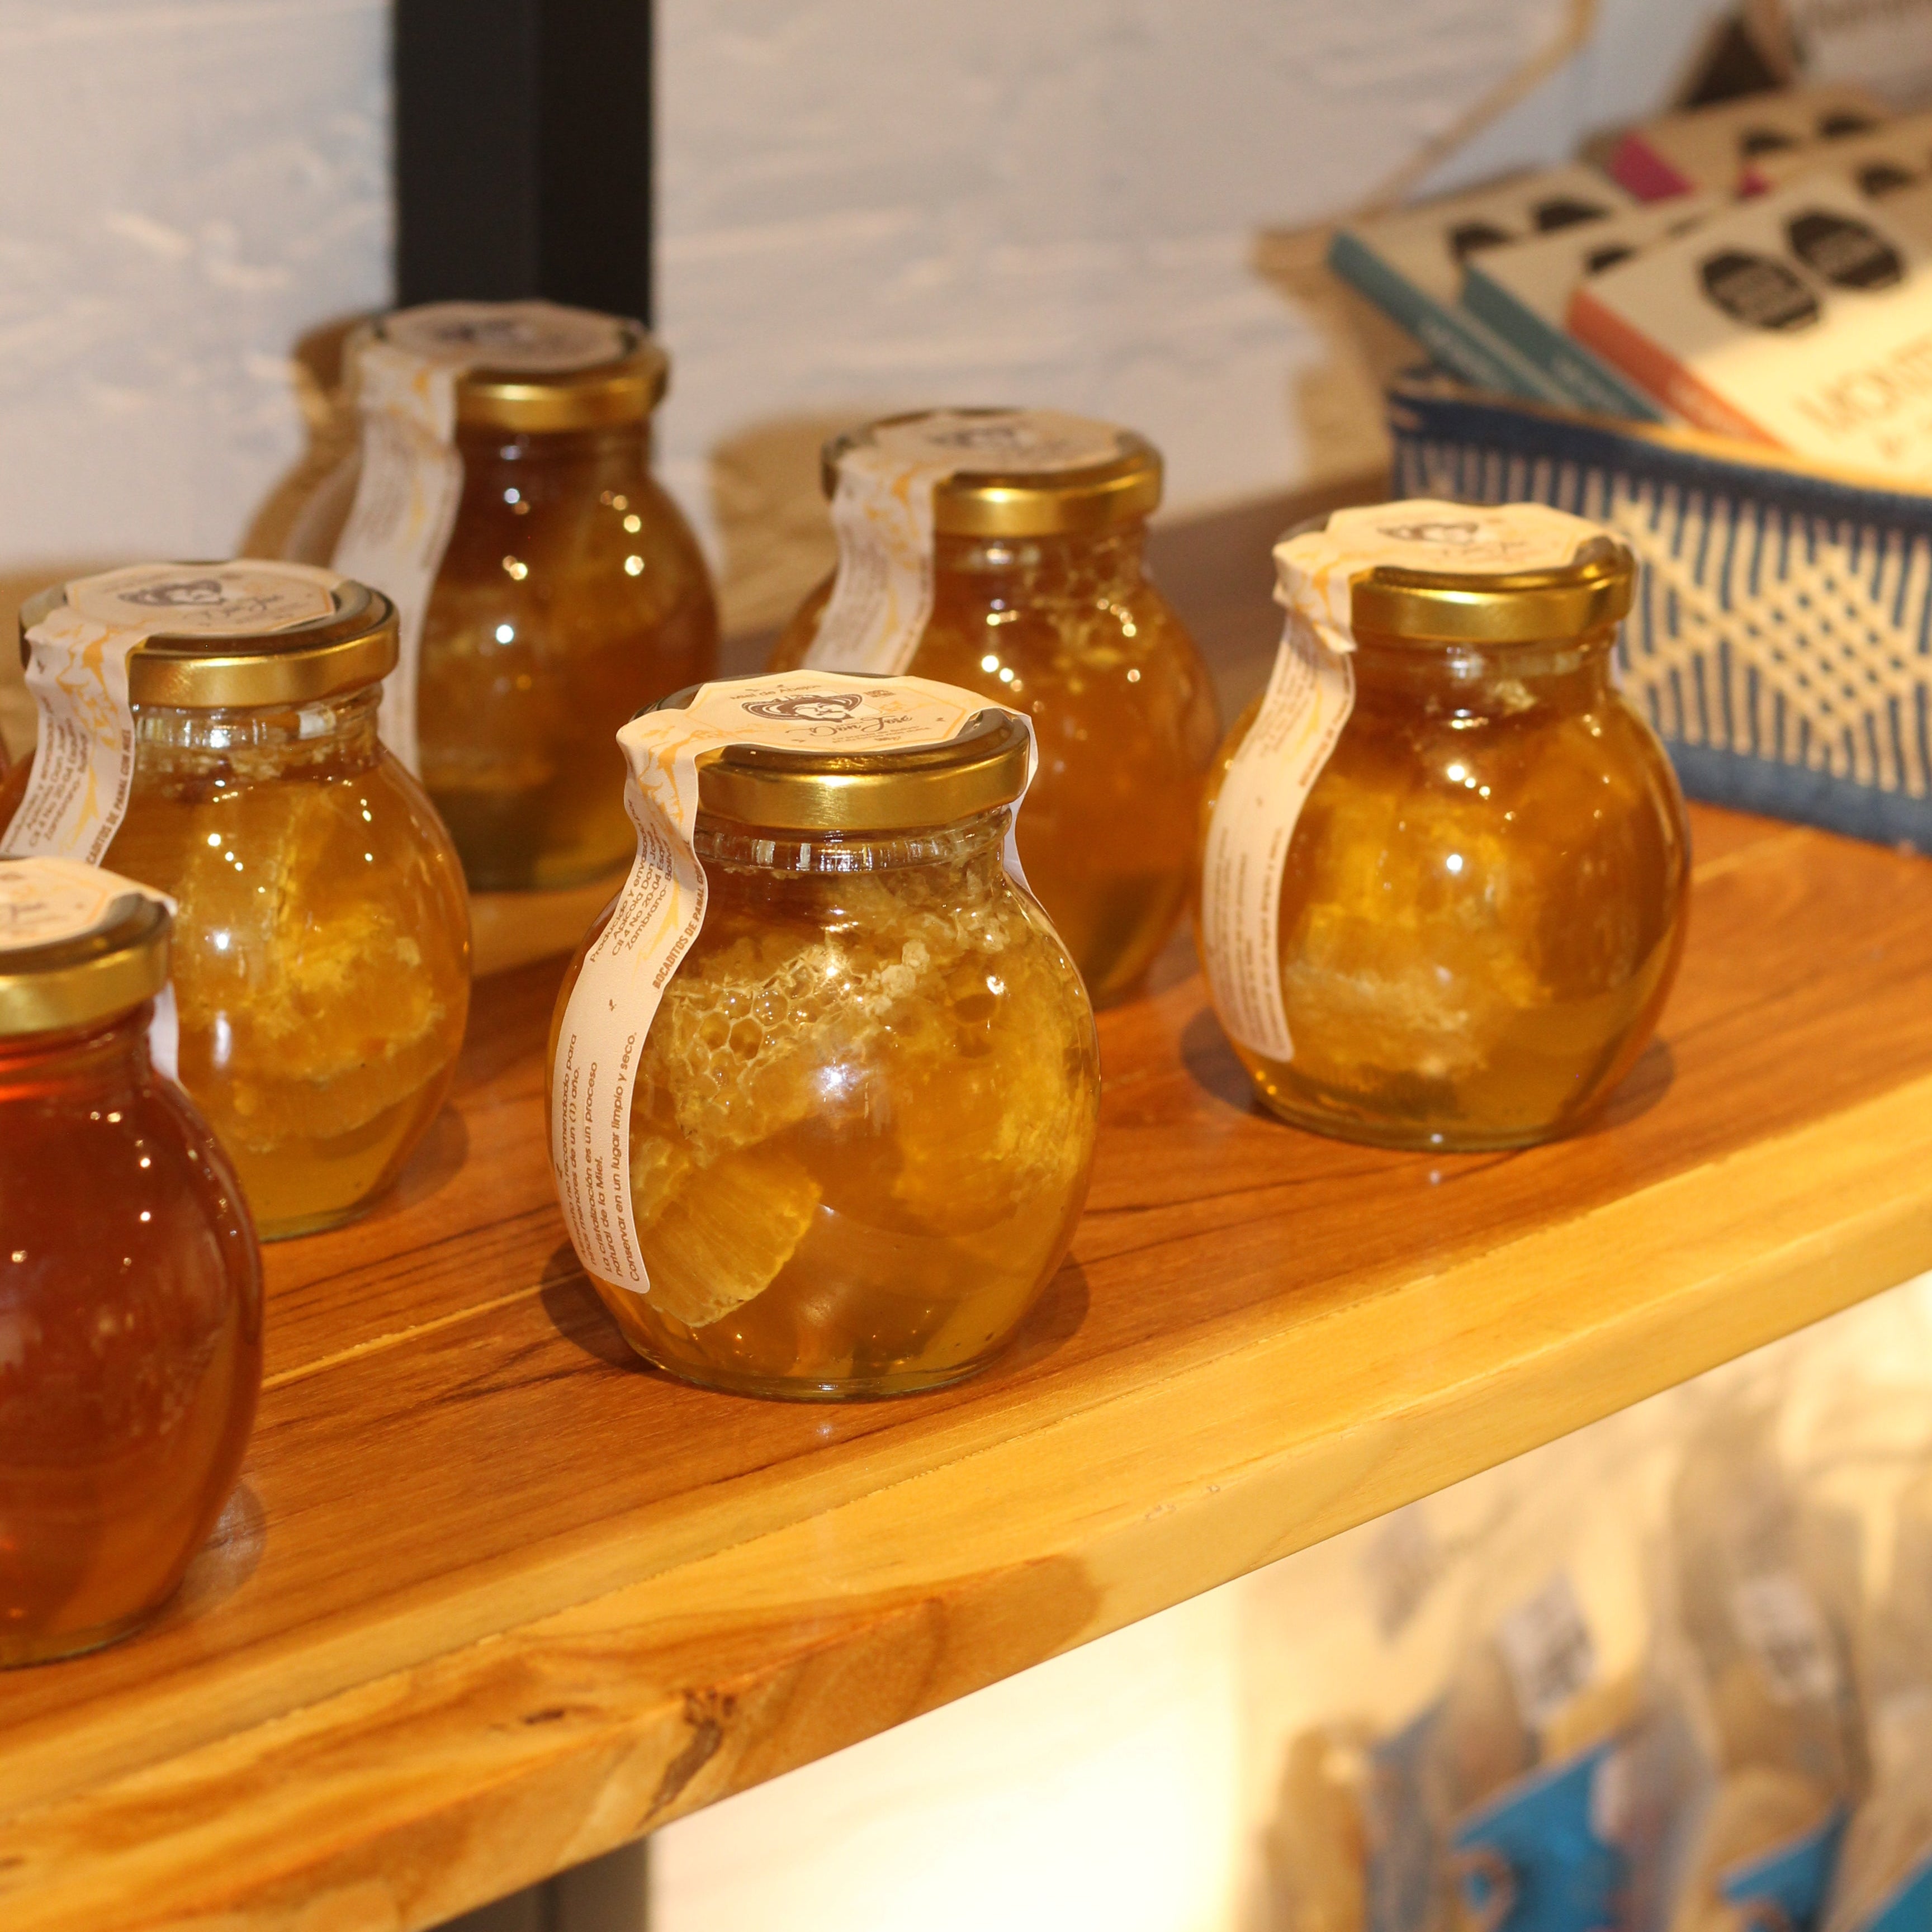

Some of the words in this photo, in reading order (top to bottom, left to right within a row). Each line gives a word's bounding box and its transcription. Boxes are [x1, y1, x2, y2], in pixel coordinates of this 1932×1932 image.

[106, 810, 119, 826] DE
[641, 863, 654, 891] Don
[590, 900, 628, 963] Producido
[633, 823, 647, 888] envasado
[623, 929, 630, 937] 4
[629, 910, 642, 928] No
[642, 873, 662, 908] 20-04
[652, 935, 688, 989] BOCADITOS
[684, 922, 698, 937] DE
[693, 888, 704, 922] PANAL
[566, 1034, 577, 1071] para
[621, 1032, 637, 1070] seco.
[585, 1062, 597, 1123] proceso
[618, 1073, 627, 1082] y
[612, 1086, 623, 1129] limpio
[570, 1127, 575, 1145] un
[585, 1125, 591, 1144] un
[570, 1148, 577, 1168] de
[585, 1148, 591, 1164] es
[612, 1132, 622, 1169] lugar
[595, 1156, 604, 1189] Miel.
[613, 1175, 621, 1191] un
[566, 1180, 572, 1199] no
[571, 1172, 586, 1230] menores
[598, 1193, 605, 1206] la
[614, 1195, 623, 1213] en
[585, 1168, 605, 1254] cristalización
[600, 1209, 609, 1229] de
[605, 1232, 623, 1277] natural
[617, 1216, 640, 1282] Conservar
[603, 1257, 612, 1273] La
